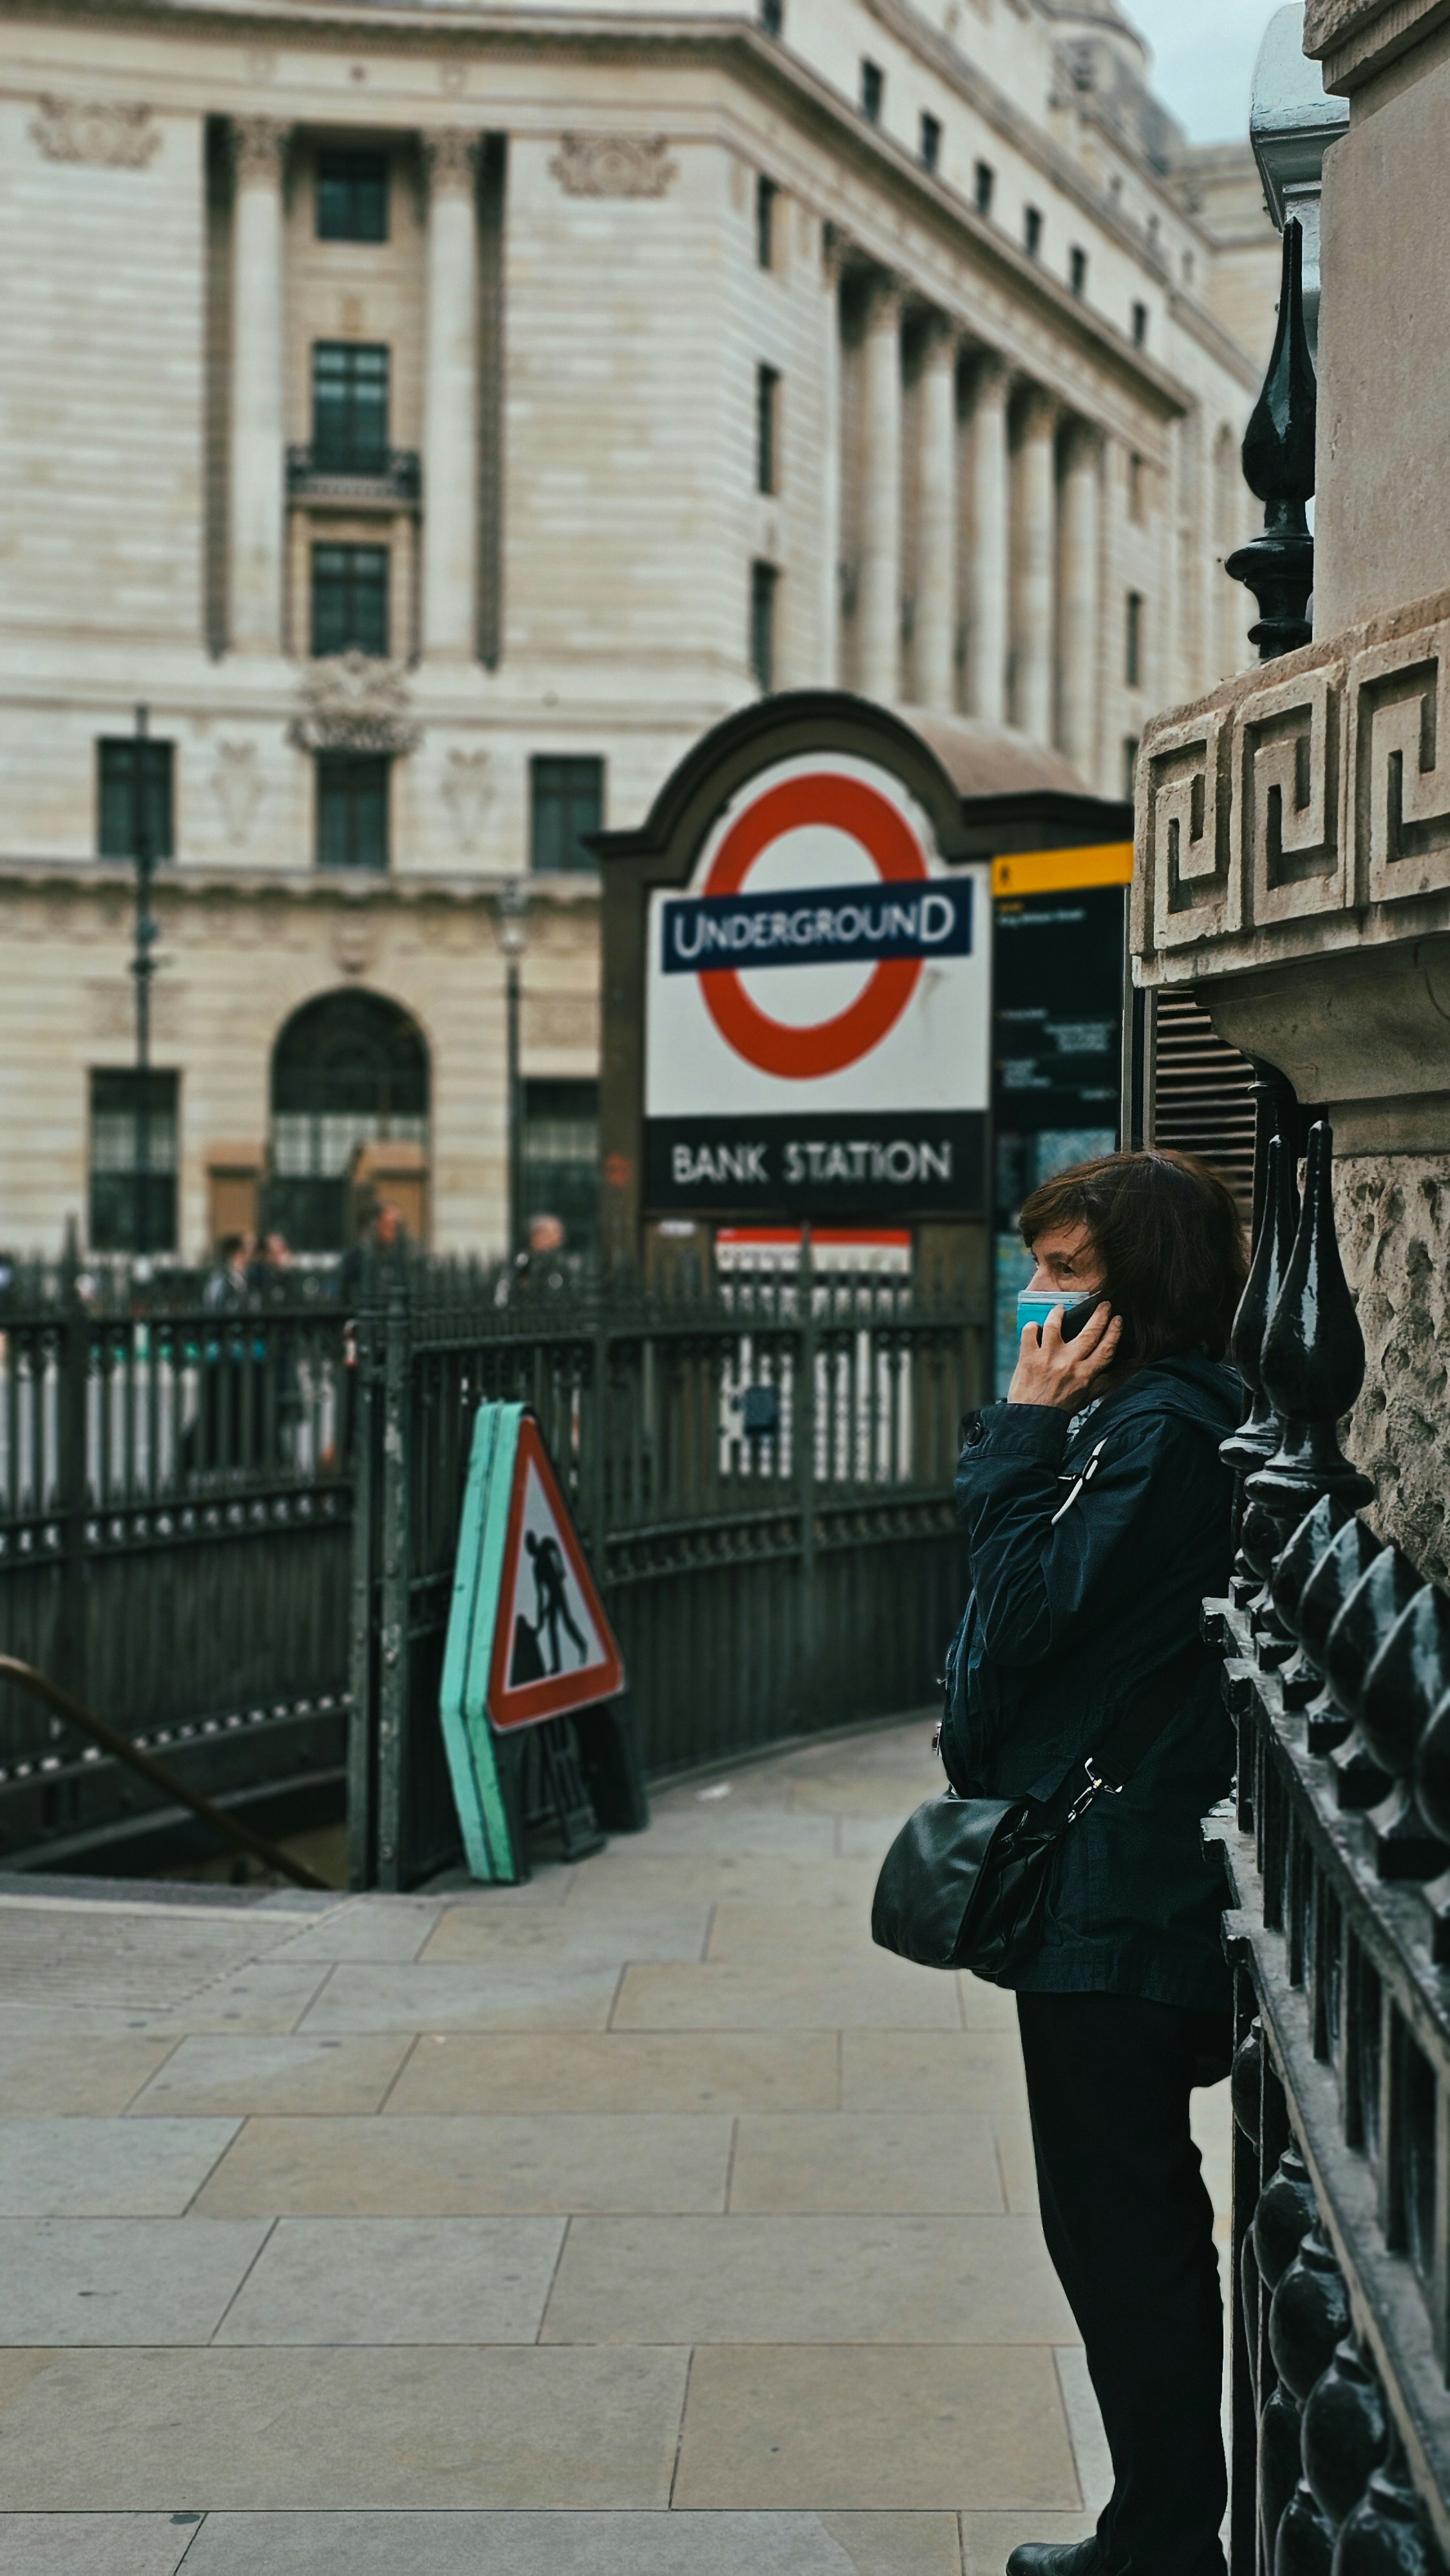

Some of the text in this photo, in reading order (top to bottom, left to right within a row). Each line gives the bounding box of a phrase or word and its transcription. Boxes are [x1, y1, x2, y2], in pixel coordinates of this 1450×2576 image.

[673, 895, 956, 958] UNDERGROUND
[672, 1142, 769, 1184] BANK
[784, 1140, 952, 1182] STATION
